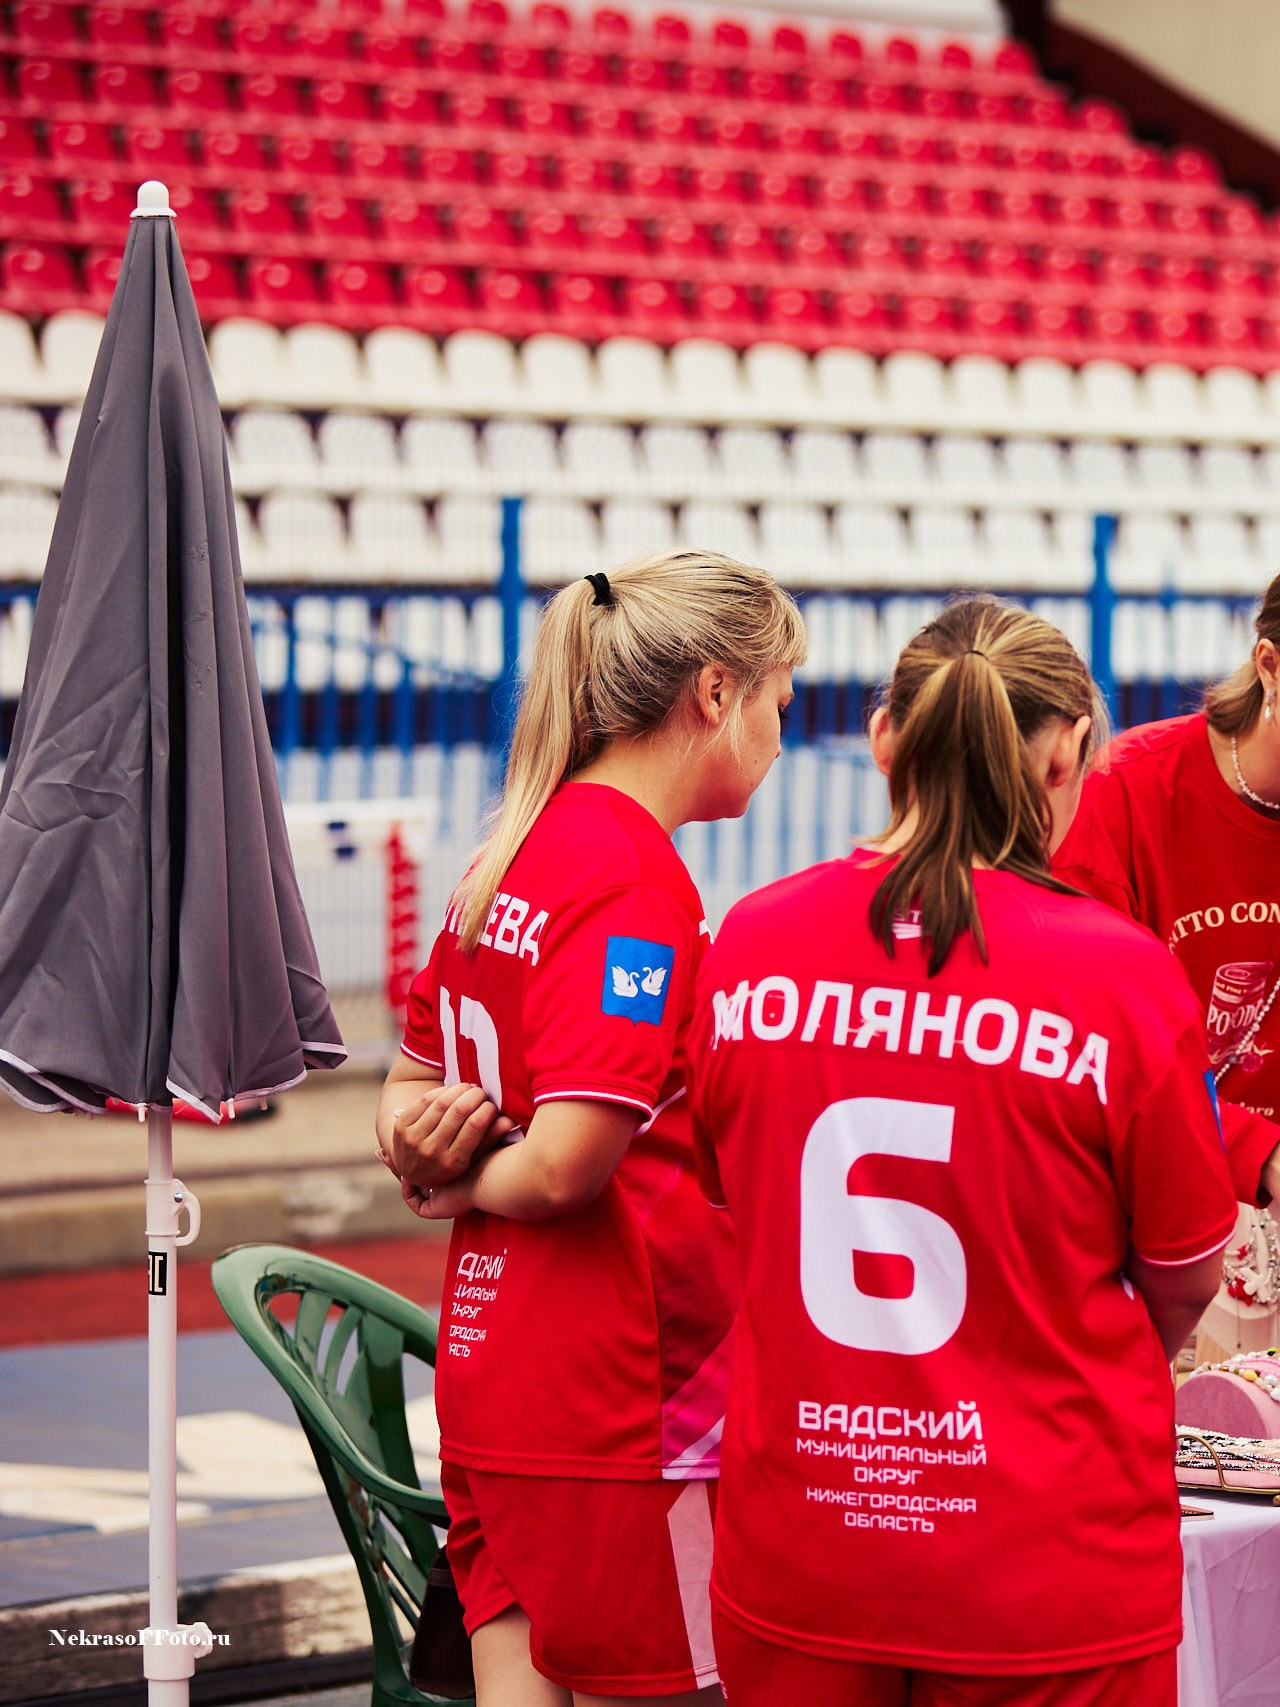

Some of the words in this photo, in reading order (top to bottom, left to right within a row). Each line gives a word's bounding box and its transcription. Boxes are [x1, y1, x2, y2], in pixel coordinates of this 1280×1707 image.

[800, 1096, 968, 1356] 6
[798, 1400, 983, 1441] ВАДСКИЙ
[796, 1437, 987, 1465] МУНИЦИПАЛЬНЫЙ
[853, 1466, 924, 1485] ОКРУГ
[806, 1486, 977, 1514] НИЖЕГОРОДСКАЯ
[844, 1511, 935, 1533] ОБЛАСТЬ
